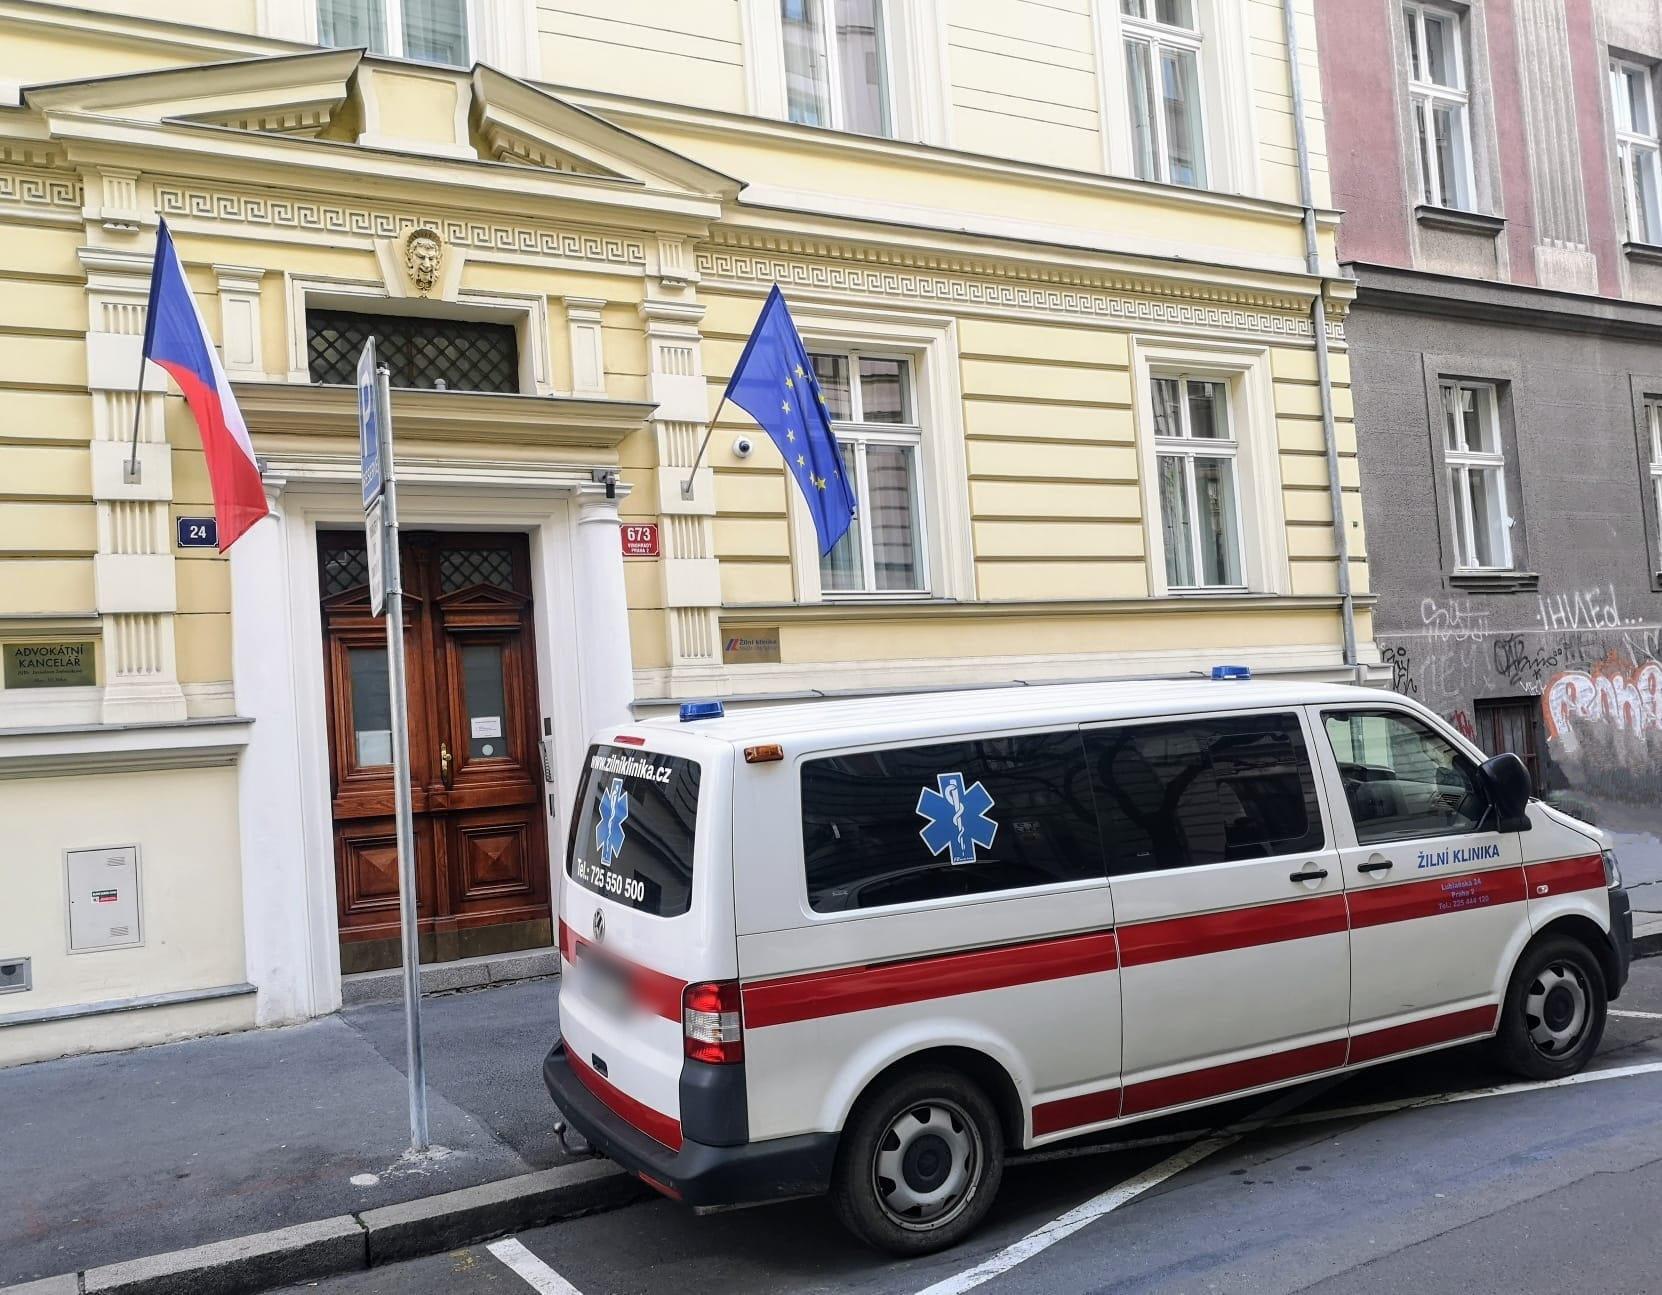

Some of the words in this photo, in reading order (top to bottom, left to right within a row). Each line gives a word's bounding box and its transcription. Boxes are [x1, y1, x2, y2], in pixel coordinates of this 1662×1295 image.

[361, 370, 371, 457] P
[190, 525, 207, 539] 24
[627, 527, 651, 541] 673
[15, 644, 84, 657] ADVOKÁTNÍ
[19, 655, 81, 668] KANCELÁŘ
[590, 755, 672, 784] www.zilniklinika.cz
[1417, 847, 1449, 869] ŽILNÍ
[1453, 844, 1500, 864] KLINIKA
[577, 858, 589, 881] Tel.:
[590, 865, 605, 888] 725
[605, 872, 623, 895] 550
[624, 878, 645, 902] 500
[1451, 889, 1470, 898] Praha
